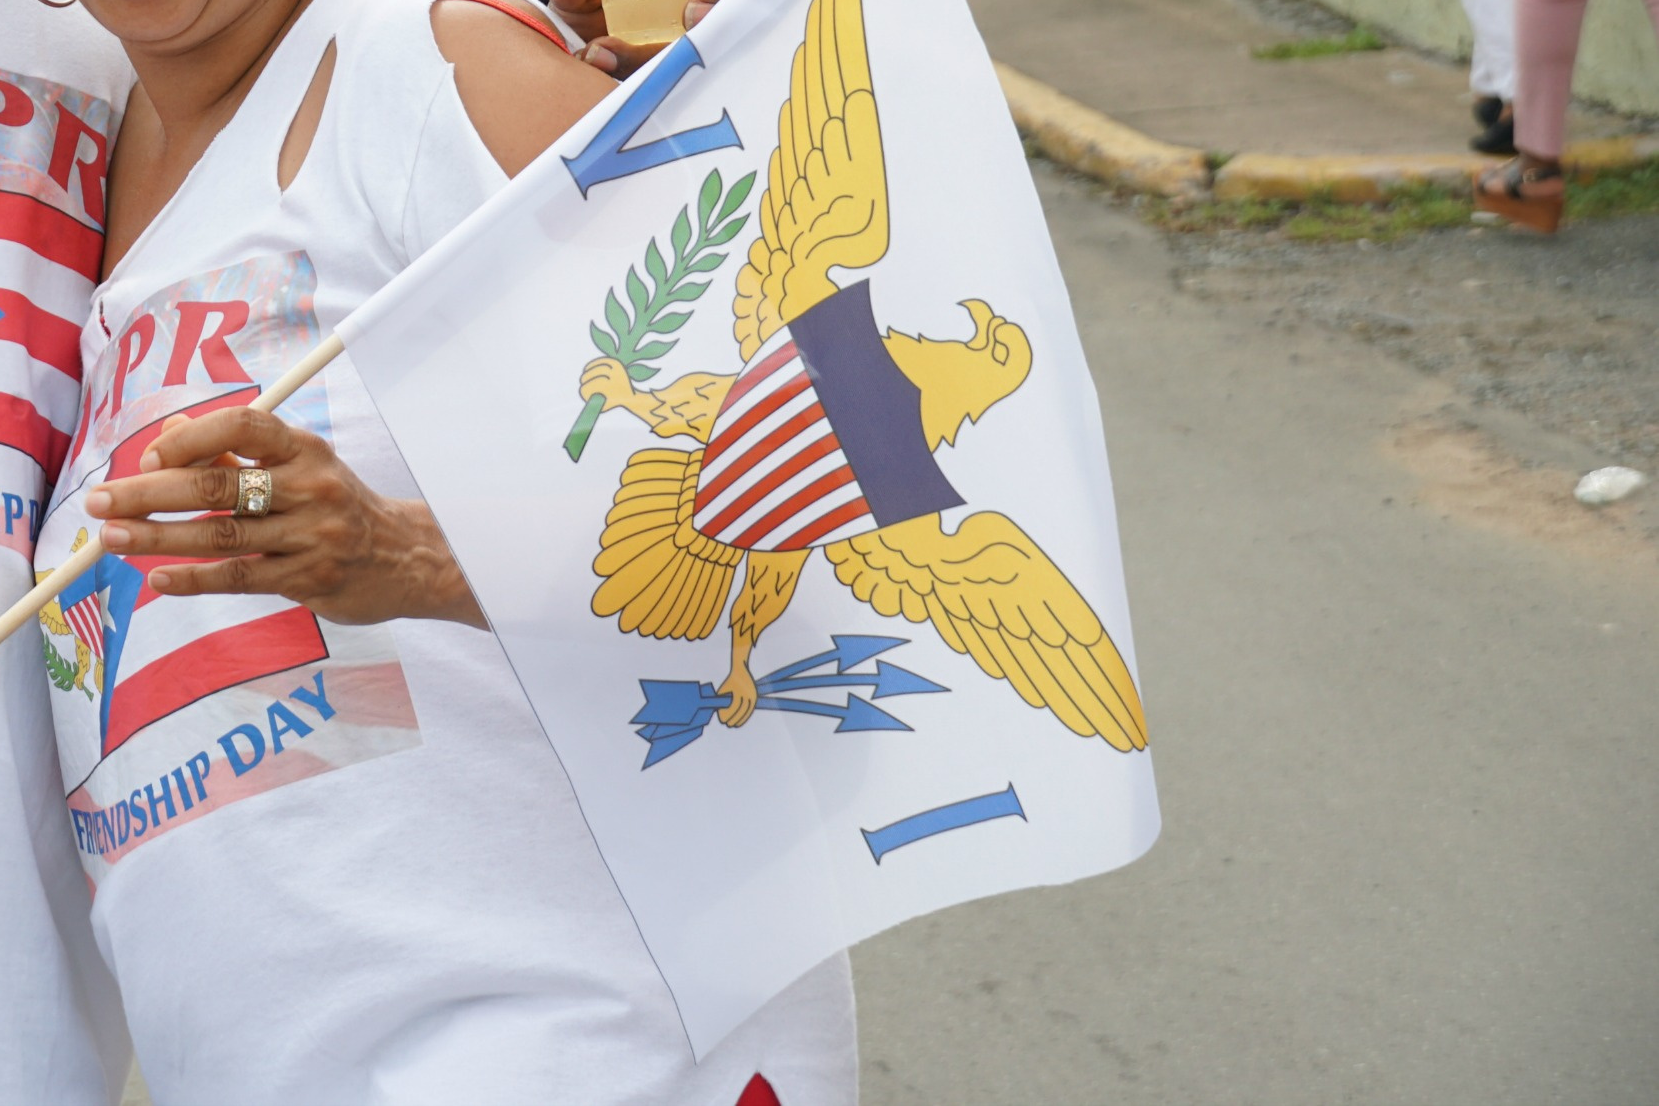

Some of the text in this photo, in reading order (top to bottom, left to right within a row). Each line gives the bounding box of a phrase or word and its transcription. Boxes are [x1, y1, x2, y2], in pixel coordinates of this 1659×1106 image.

[560, 33, 744, 200] V
[70, 669, 336, 855] FRIENDSHIP DAY
